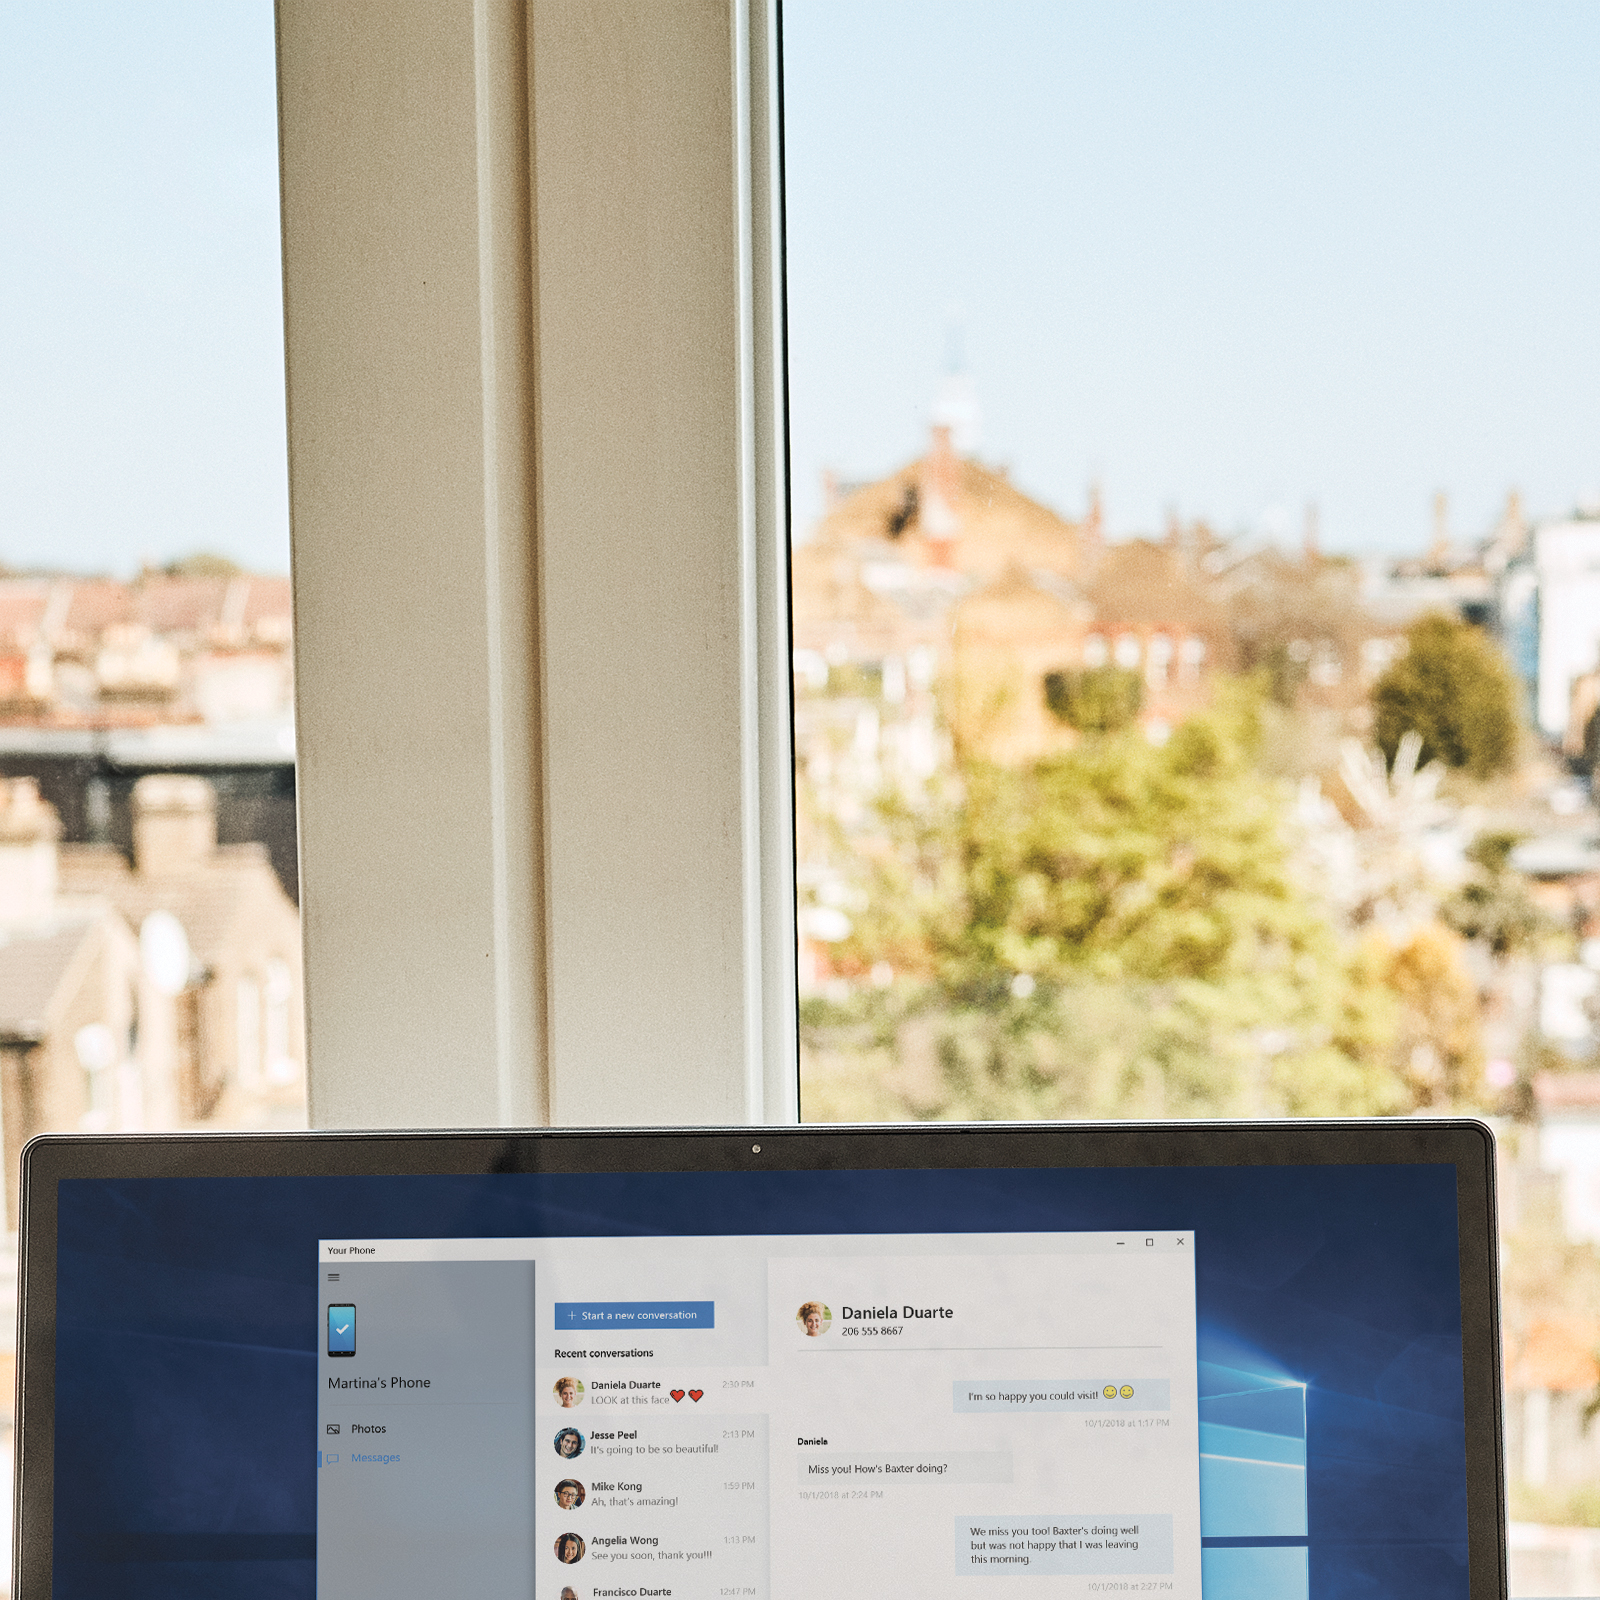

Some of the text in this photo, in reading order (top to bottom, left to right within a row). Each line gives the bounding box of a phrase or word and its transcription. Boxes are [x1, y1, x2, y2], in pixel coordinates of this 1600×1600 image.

[327, 1246, 376, 1255] Your Phone
[581, 1311, 605, 1321] Start
[636, 1311, 697, 1320] conversation
[842, 1305, 954, 1320] Daniela Duarte
[841, 1325, 904, 1337] 206 555 8667
[554, 1347, 654, 1359] Recent conversations
[328, 1376, 431, 1390] Martina's Phone
[591, 1380, 662, 1390] Daniela Duarte
[591, 1394, 670, 1405] LOOK at this face
[968, 1390, 1099, 1404] I'm so happy you could visit!
[351, 1423, 387, 1434] Photos
[589, 1429, 638, 1440] Jesse Peel
[797, 1436, 829, 1446] Daniela
[590, 1443, 719, 1457] It's going to be so beautiful!
[351, 1453, 401, 1465] Messages
[808, 1463, 948, 1476] Miss you! How's Baxter doing?
[591, 1481, 643, 1493] Mike Kong
[590, 1496, 679, 1508] Ah, that's amazing!
[969, 1525, 1139, 1538] We miss you too! Baxter's doing well
[591, 1535, 659, 1548] Angelia Wong
[970, 1540, 986, 1551] but
[1009, 1541, 1025, 1550] not
[1027, 1539, 1057, 1552] happy
[1058, 1539, 1077, 1550] that
[1079, 1540, 1083, 1549] I
[1105, 1539, 1139, 1551] leaving
[591, 1550, 713, 1563] See you soon, thank you!!!
[970, 1554, 1033, 1566] this morning.
[593, 1587, 672, 1597] Francisco Duarte
